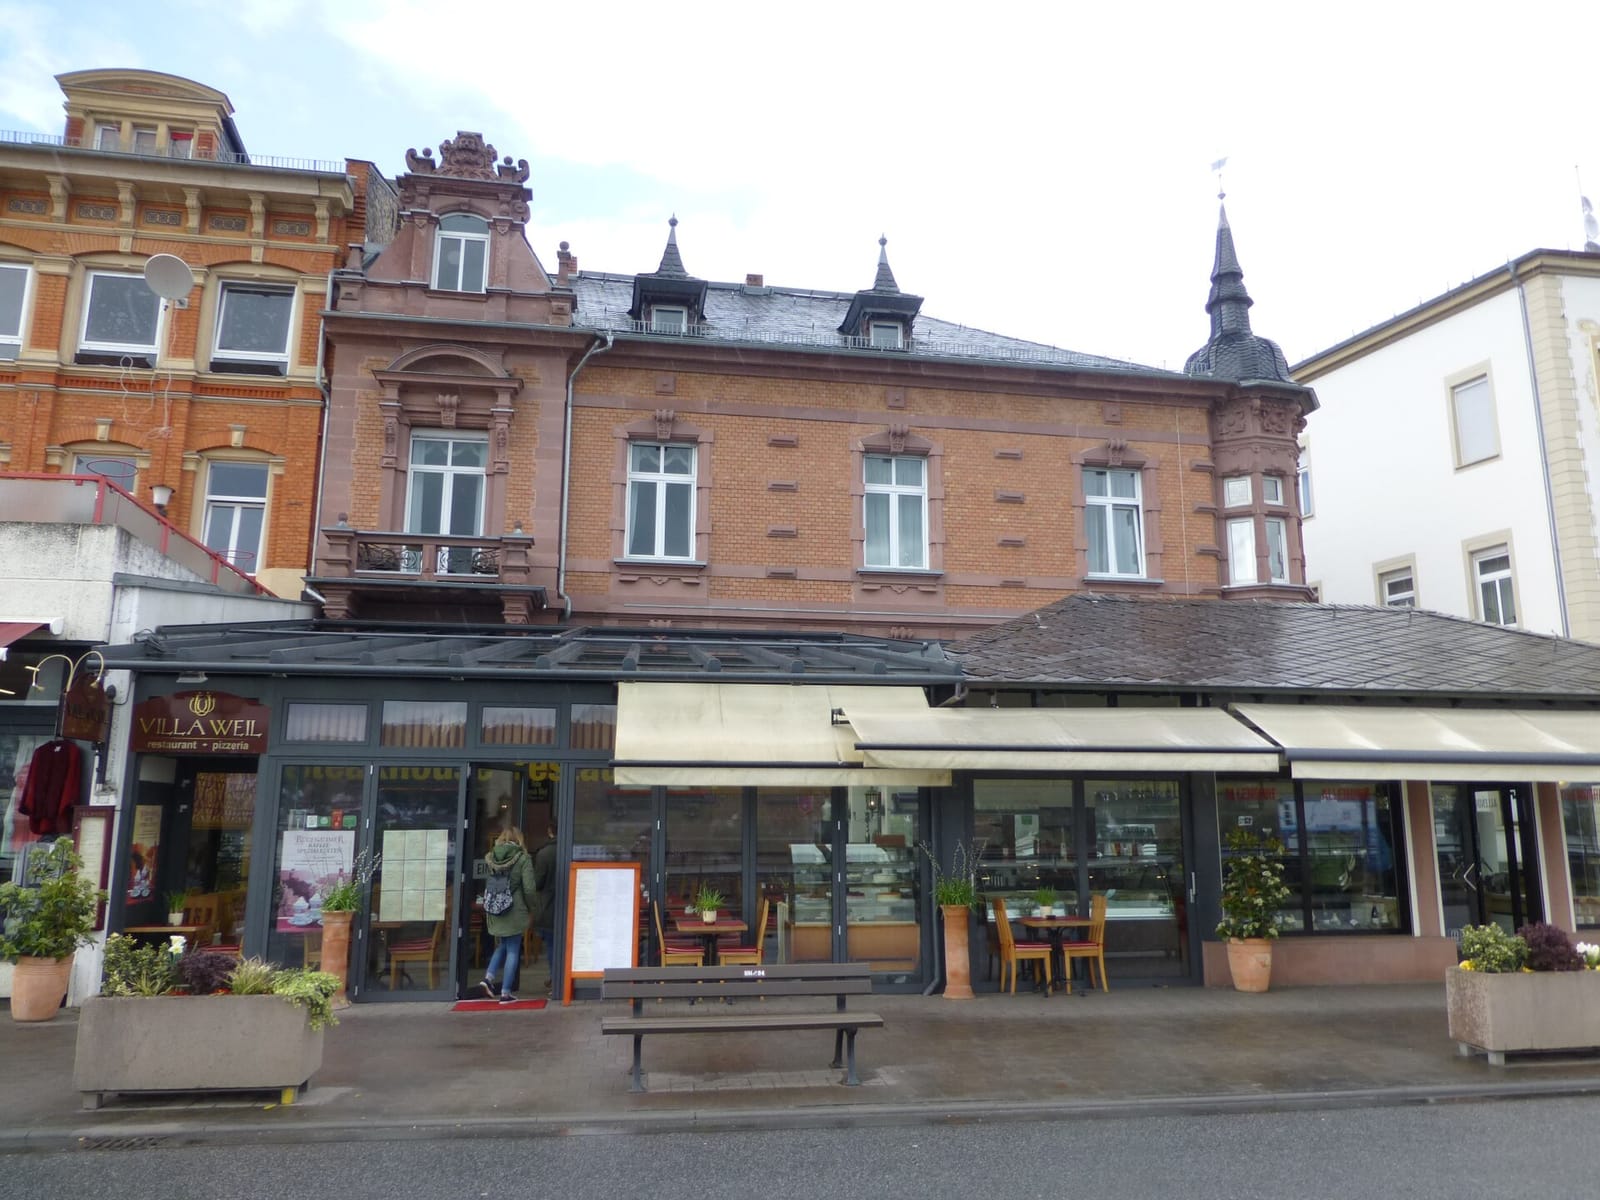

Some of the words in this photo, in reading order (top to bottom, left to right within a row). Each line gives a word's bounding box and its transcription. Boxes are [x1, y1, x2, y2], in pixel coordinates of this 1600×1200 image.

[140, 717, 206, 736] VILLA
[209, 719, 263, 737] WEIL
[147, 741, 197, 750] restaurant
[212, 741, 249, 751] pizzeria
